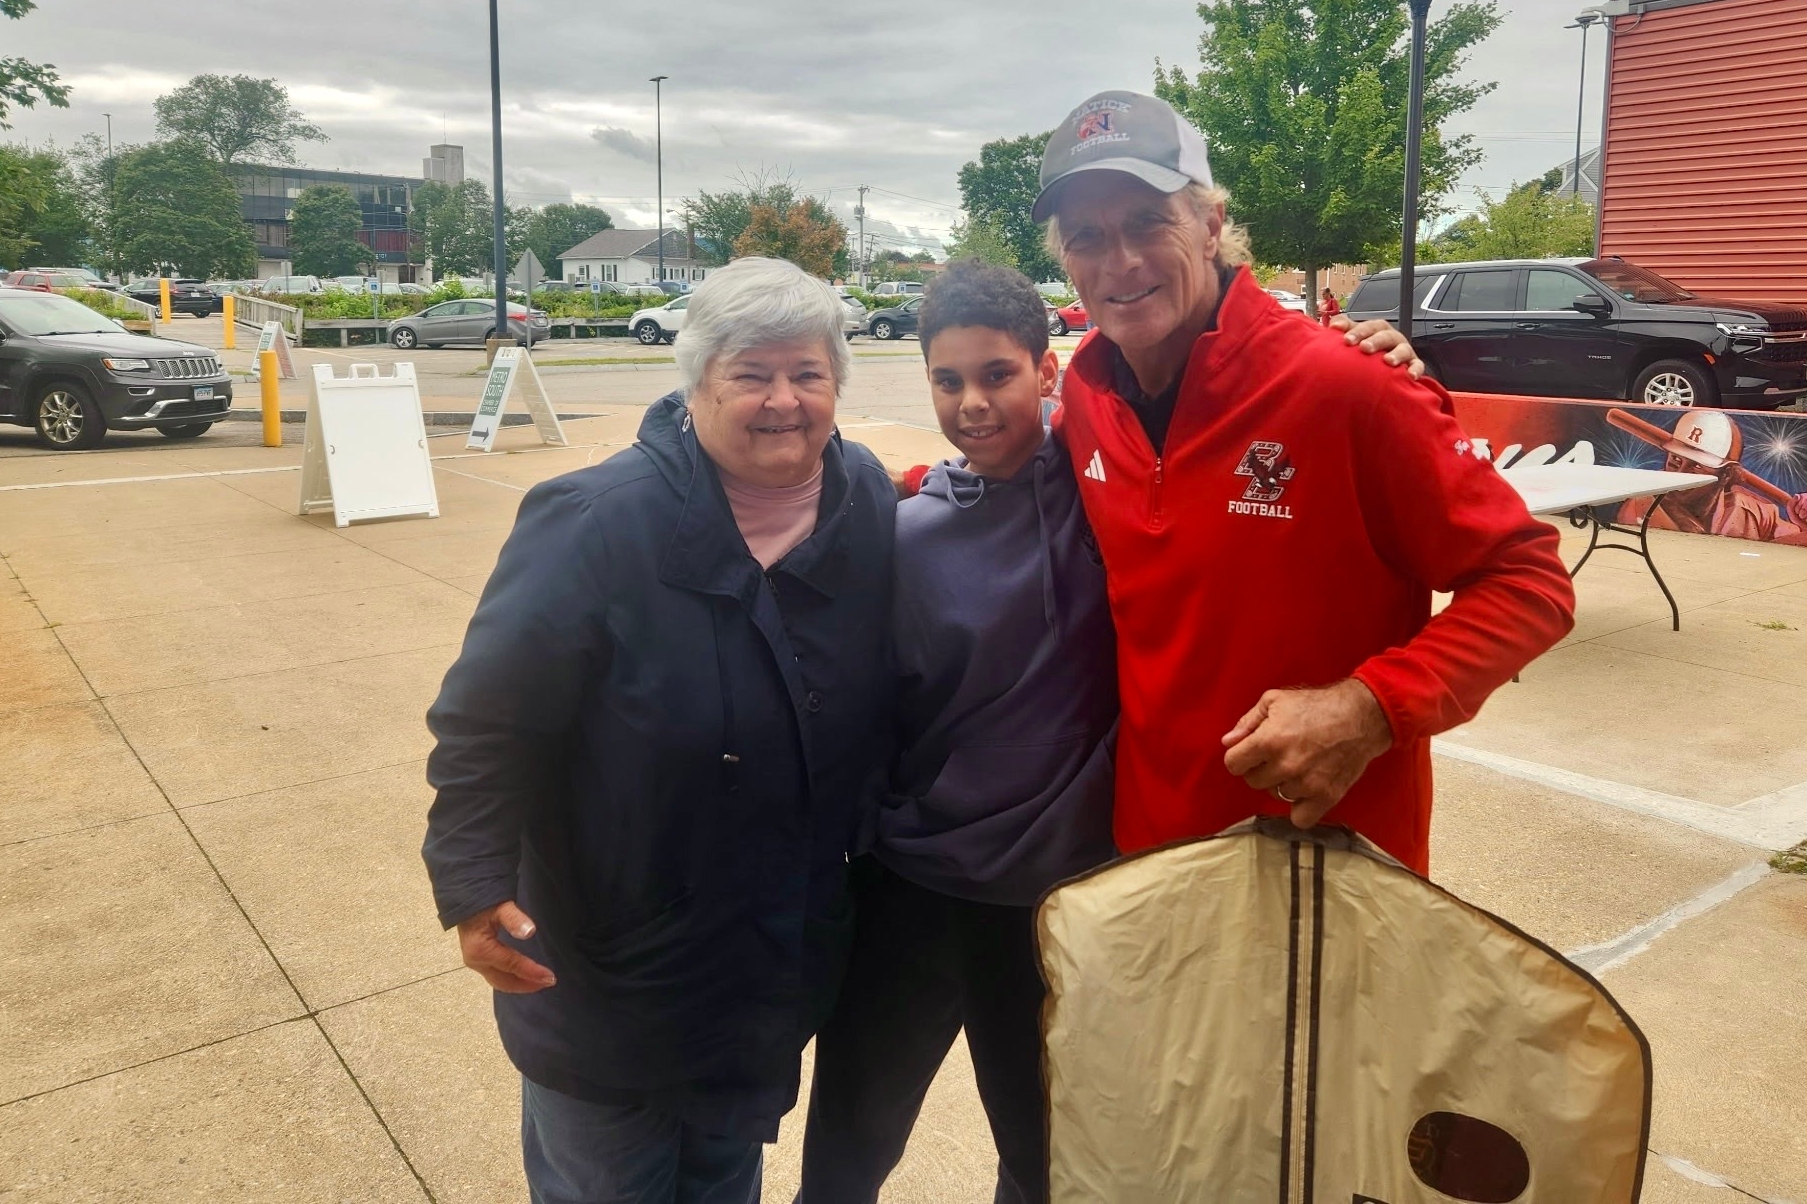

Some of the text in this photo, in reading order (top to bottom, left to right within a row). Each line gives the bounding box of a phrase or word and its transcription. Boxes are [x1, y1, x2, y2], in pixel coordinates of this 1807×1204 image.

[1072, 100, 1132, 125] NATICK
[1070, 133, 1131, 156] FOOTBALL
[490, 371, 508, 383] METRO
[486, 385, 505, 397] SOUTH
[1687, 425, 1703, 444] R
[1228, 501, 1293, 519] FOOTBALL
